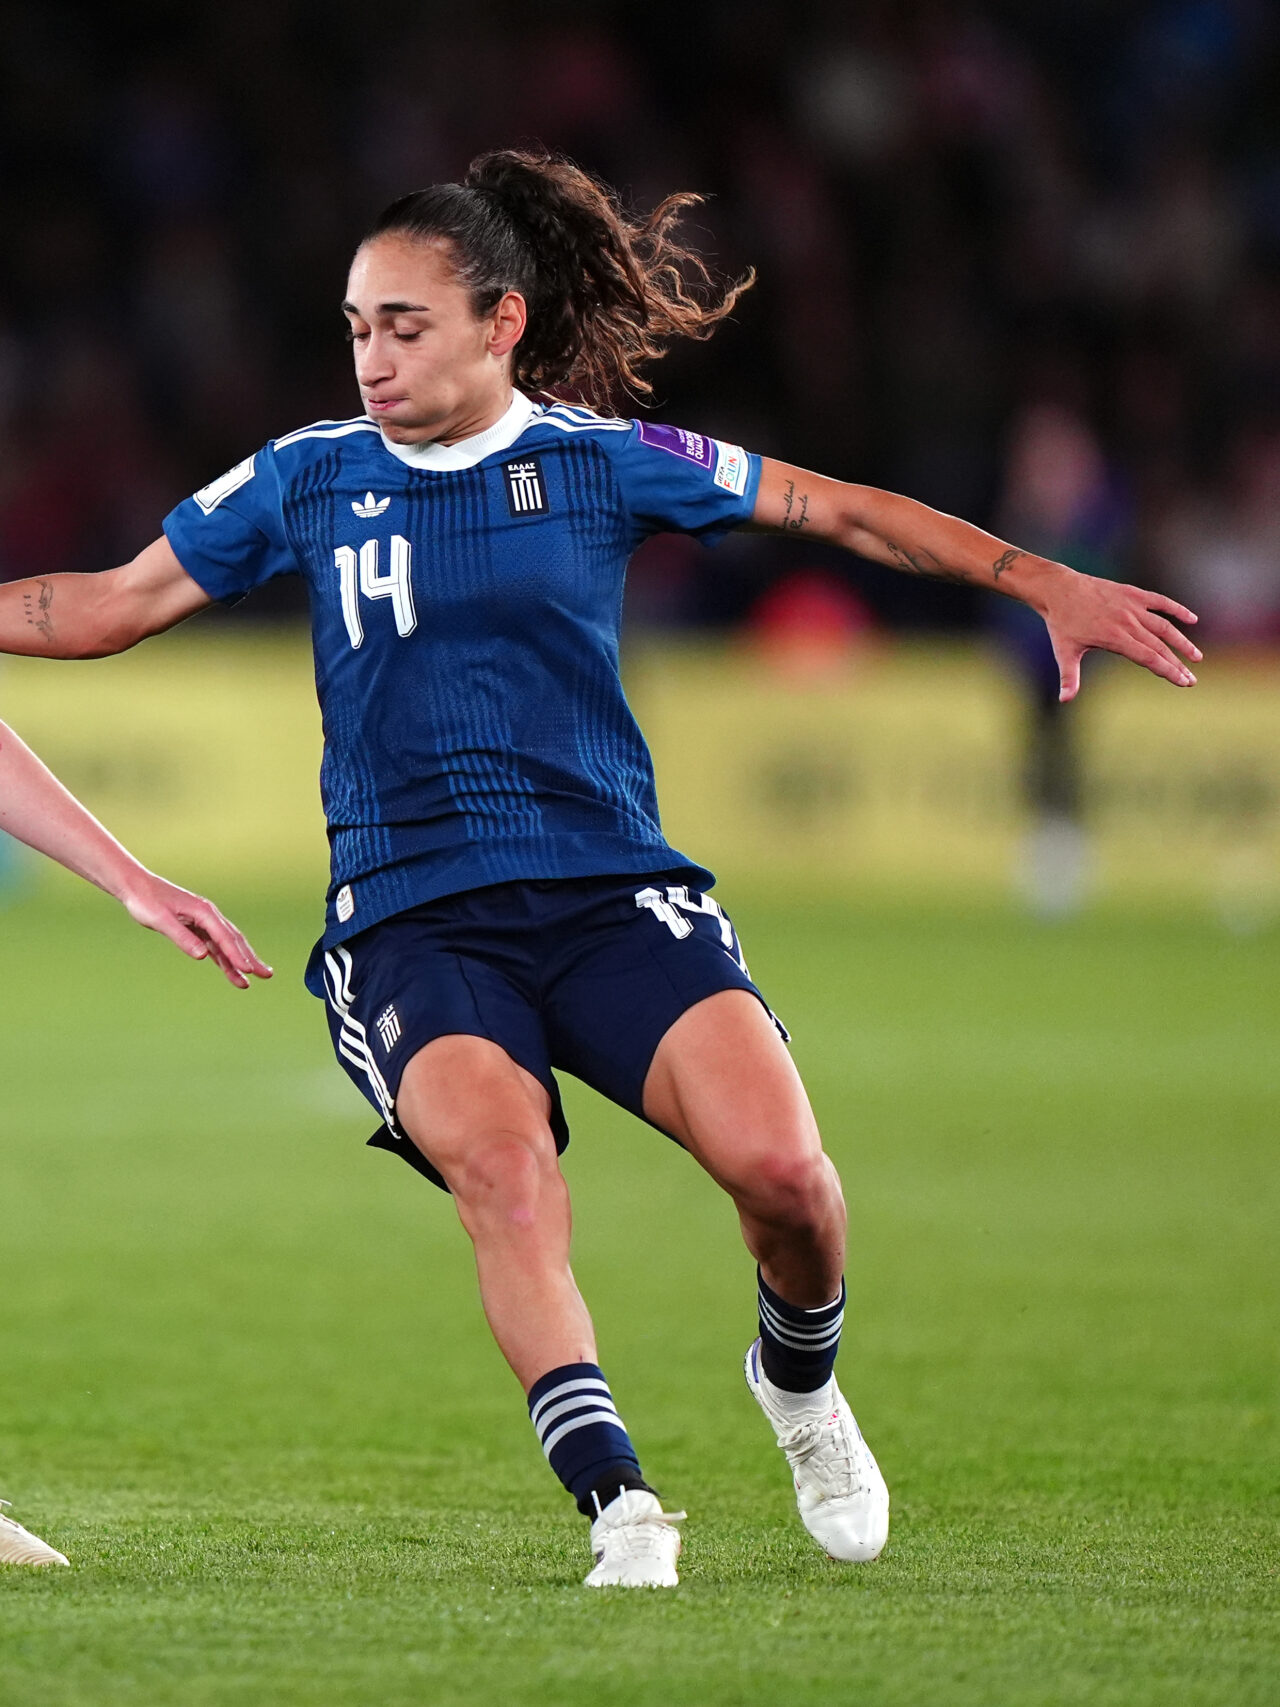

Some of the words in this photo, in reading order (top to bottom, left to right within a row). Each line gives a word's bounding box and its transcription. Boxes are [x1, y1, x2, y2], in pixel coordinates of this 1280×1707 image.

[723, 455, 738, 489] FOUN
[333, 534, 418, 650] 14
[634, 885, 734, 950] 14
